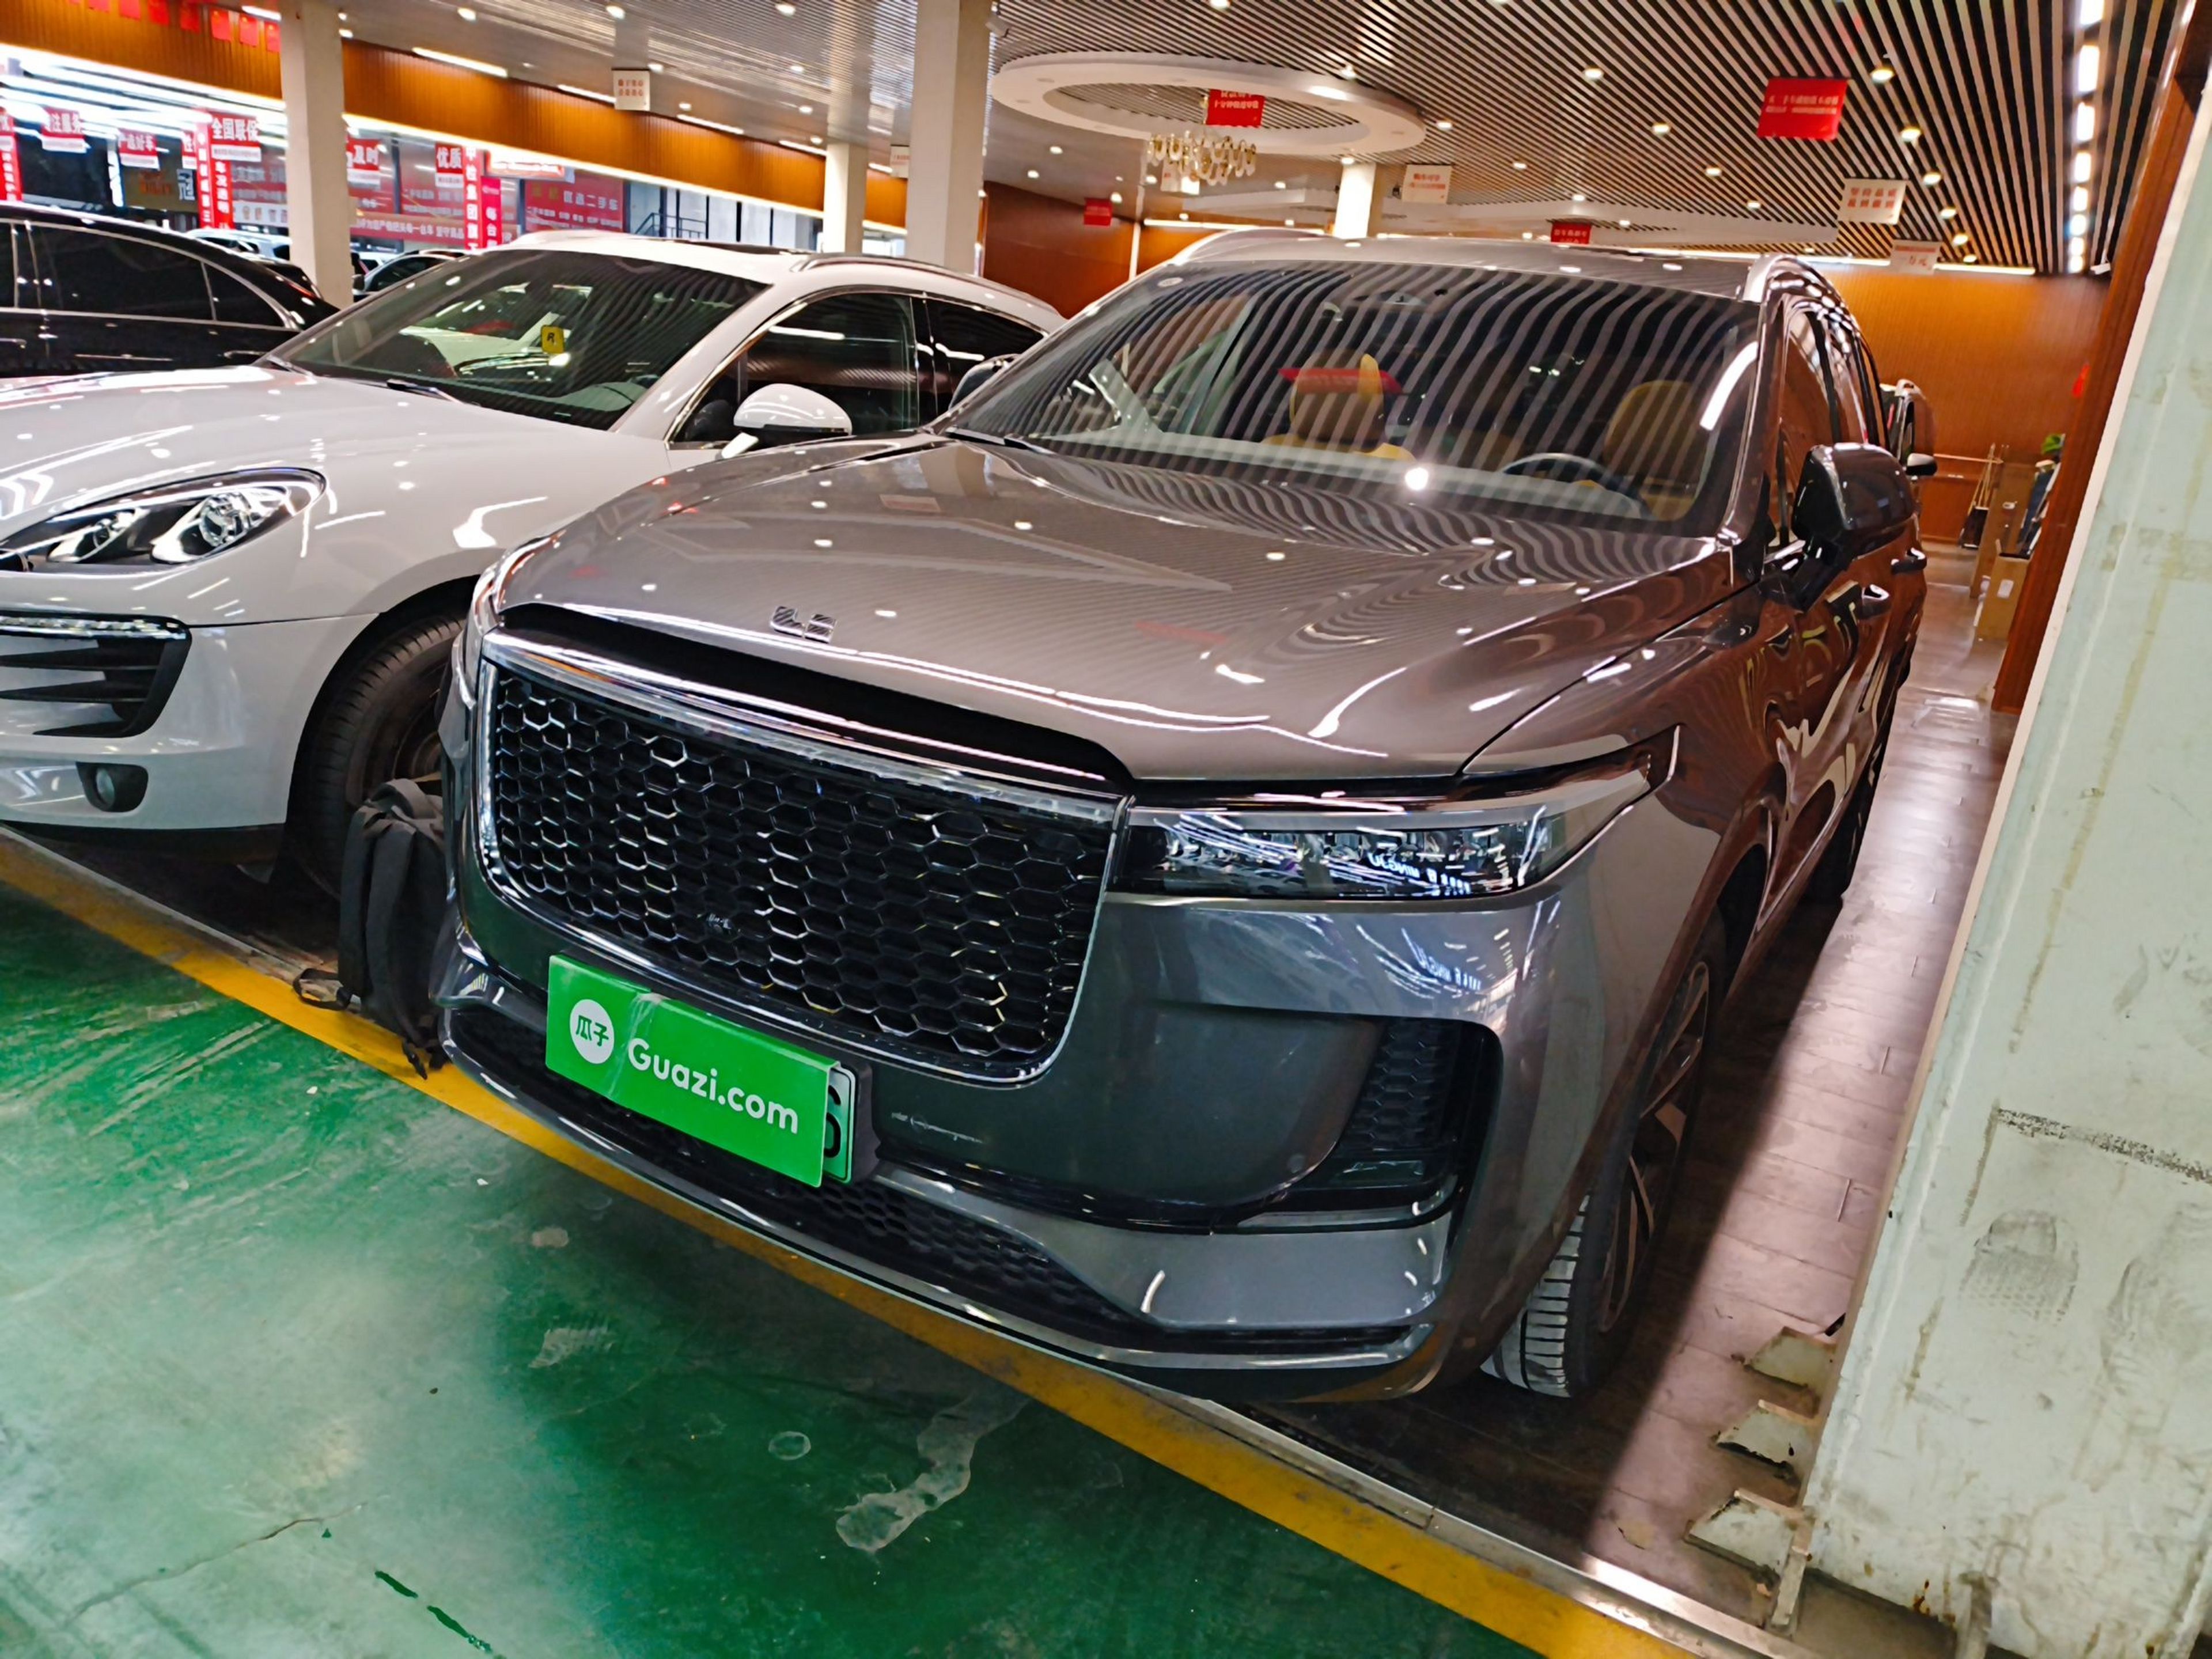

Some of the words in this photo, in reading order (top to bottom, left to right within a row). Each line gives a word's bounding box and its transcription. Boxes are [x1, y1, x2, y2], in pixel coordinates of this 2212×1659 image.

[211, 118, 259, 142] 全国联保
[575, 1014, 609, 1047] 瓜子
[628, 1037, 798, 1134] Guazi.com
